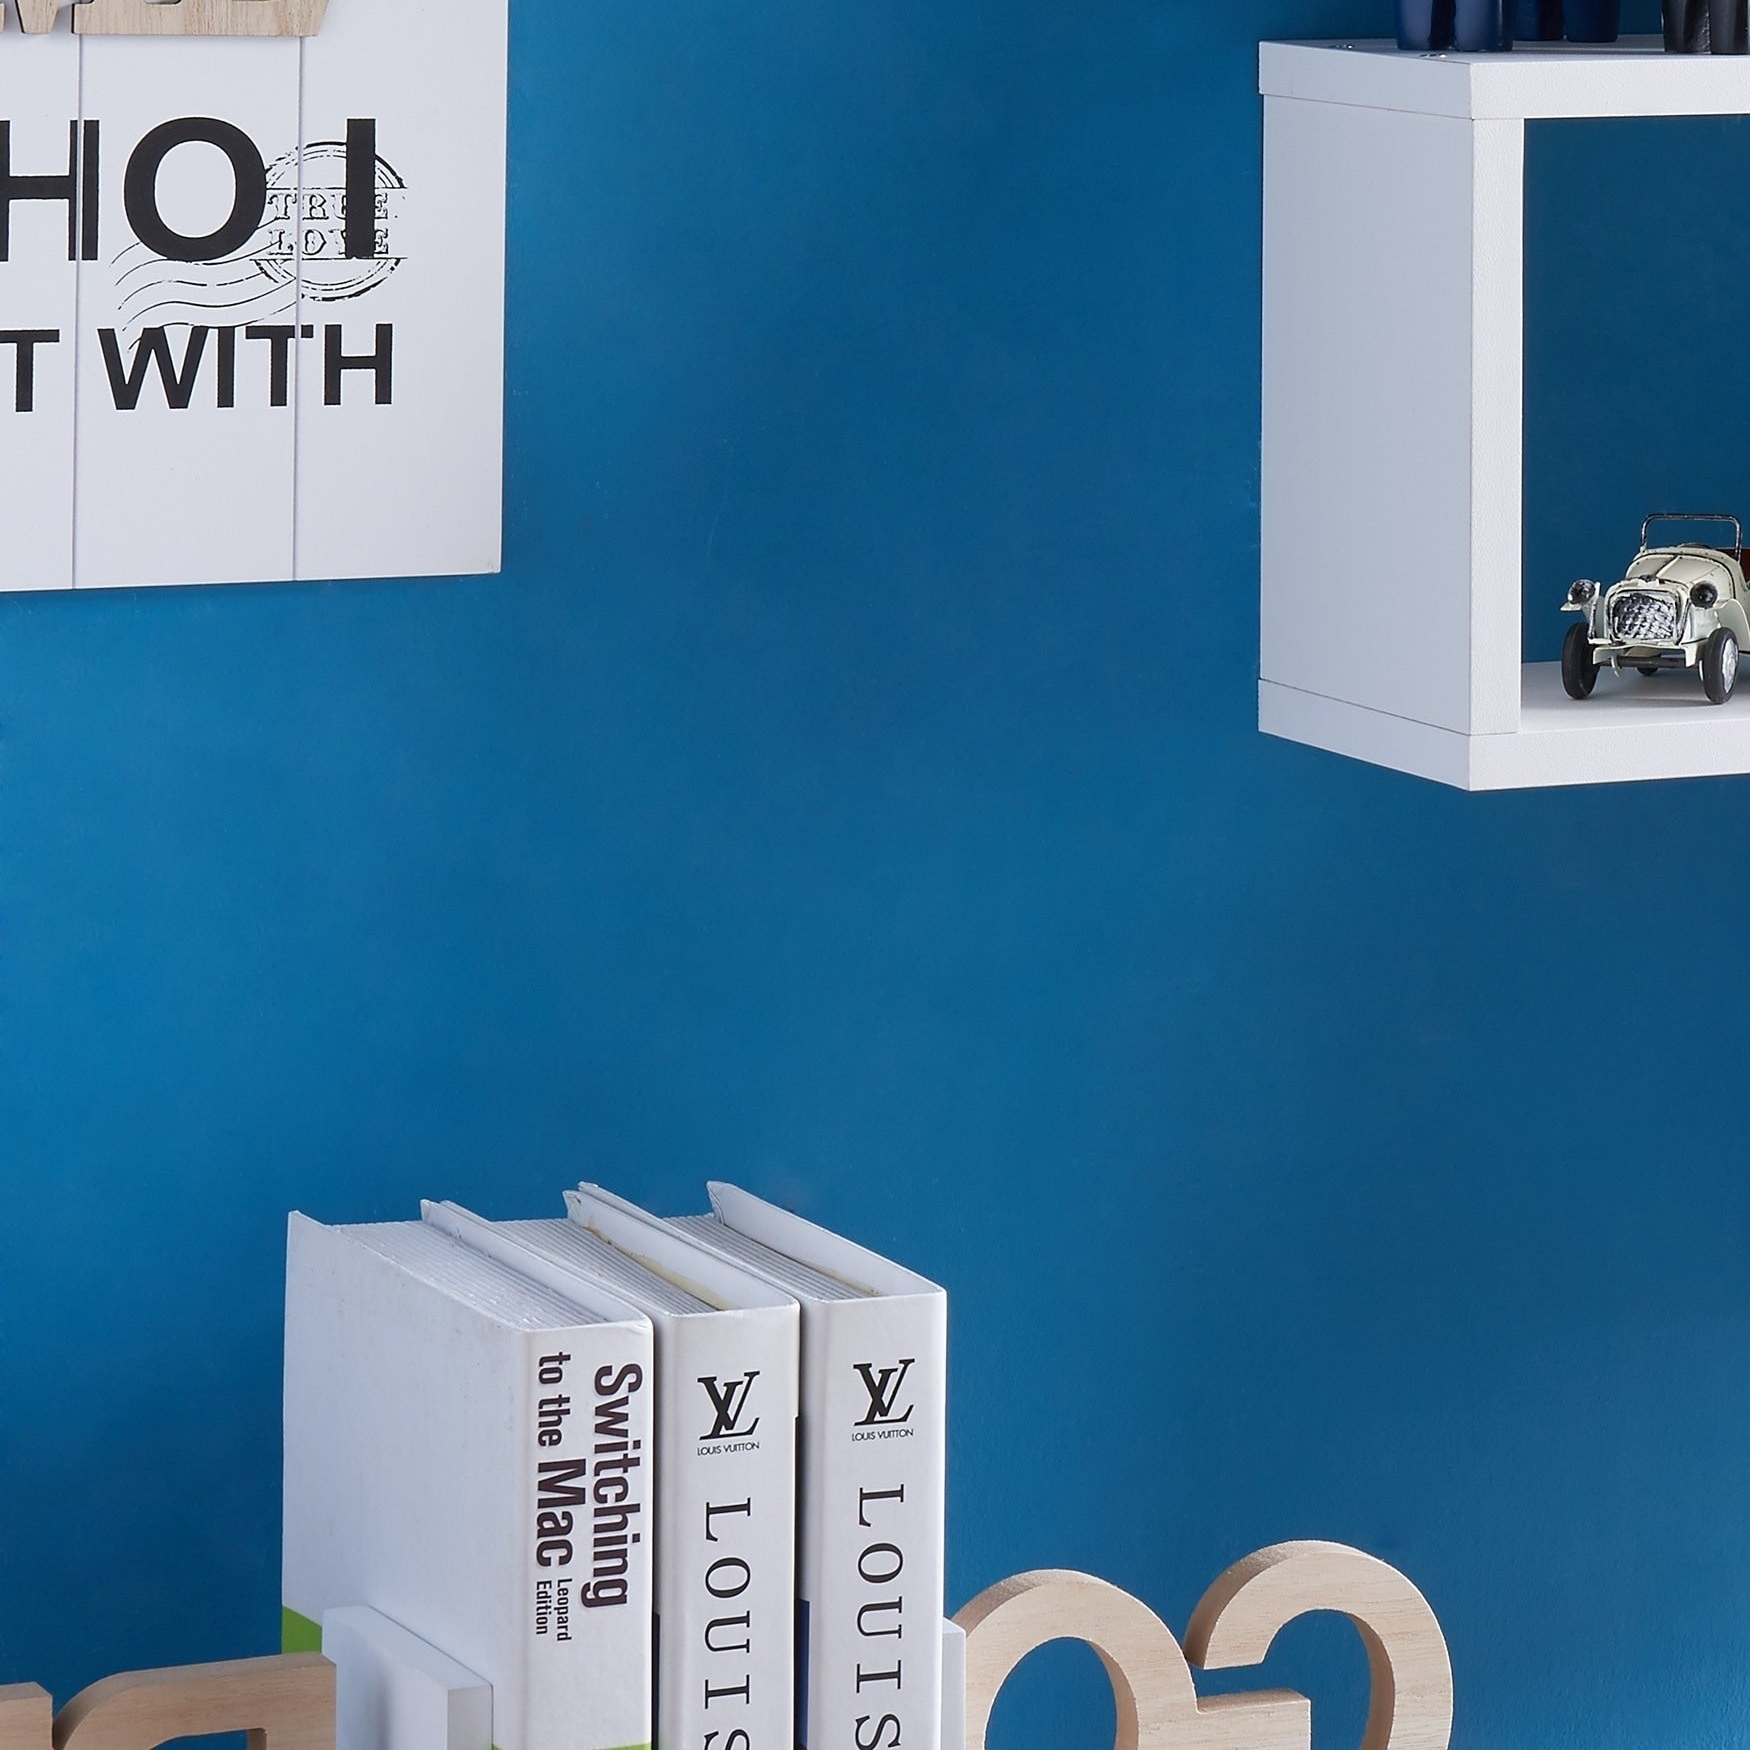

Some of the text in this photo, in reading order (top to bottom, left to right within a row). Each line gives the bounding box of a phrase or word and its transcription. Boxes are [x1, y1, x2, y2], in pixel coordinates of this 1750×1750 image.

[0, 117, 376, 262] HO I
[0, 323, 393, 412] T WITH
[536, 1351, 587, 1567] to the Mac
[697, 1441, 760, 1456] LOUIS VUITTON
[852, 1428, 914, 1442] LOUIS VUITTON
[580, 1363, 643, 1609] Switching
[536, 1580, 552, 1635] Edition
[557, 1578, 573, 1641] Leopard
[855, 1484, 904, 1750] LOUIS
